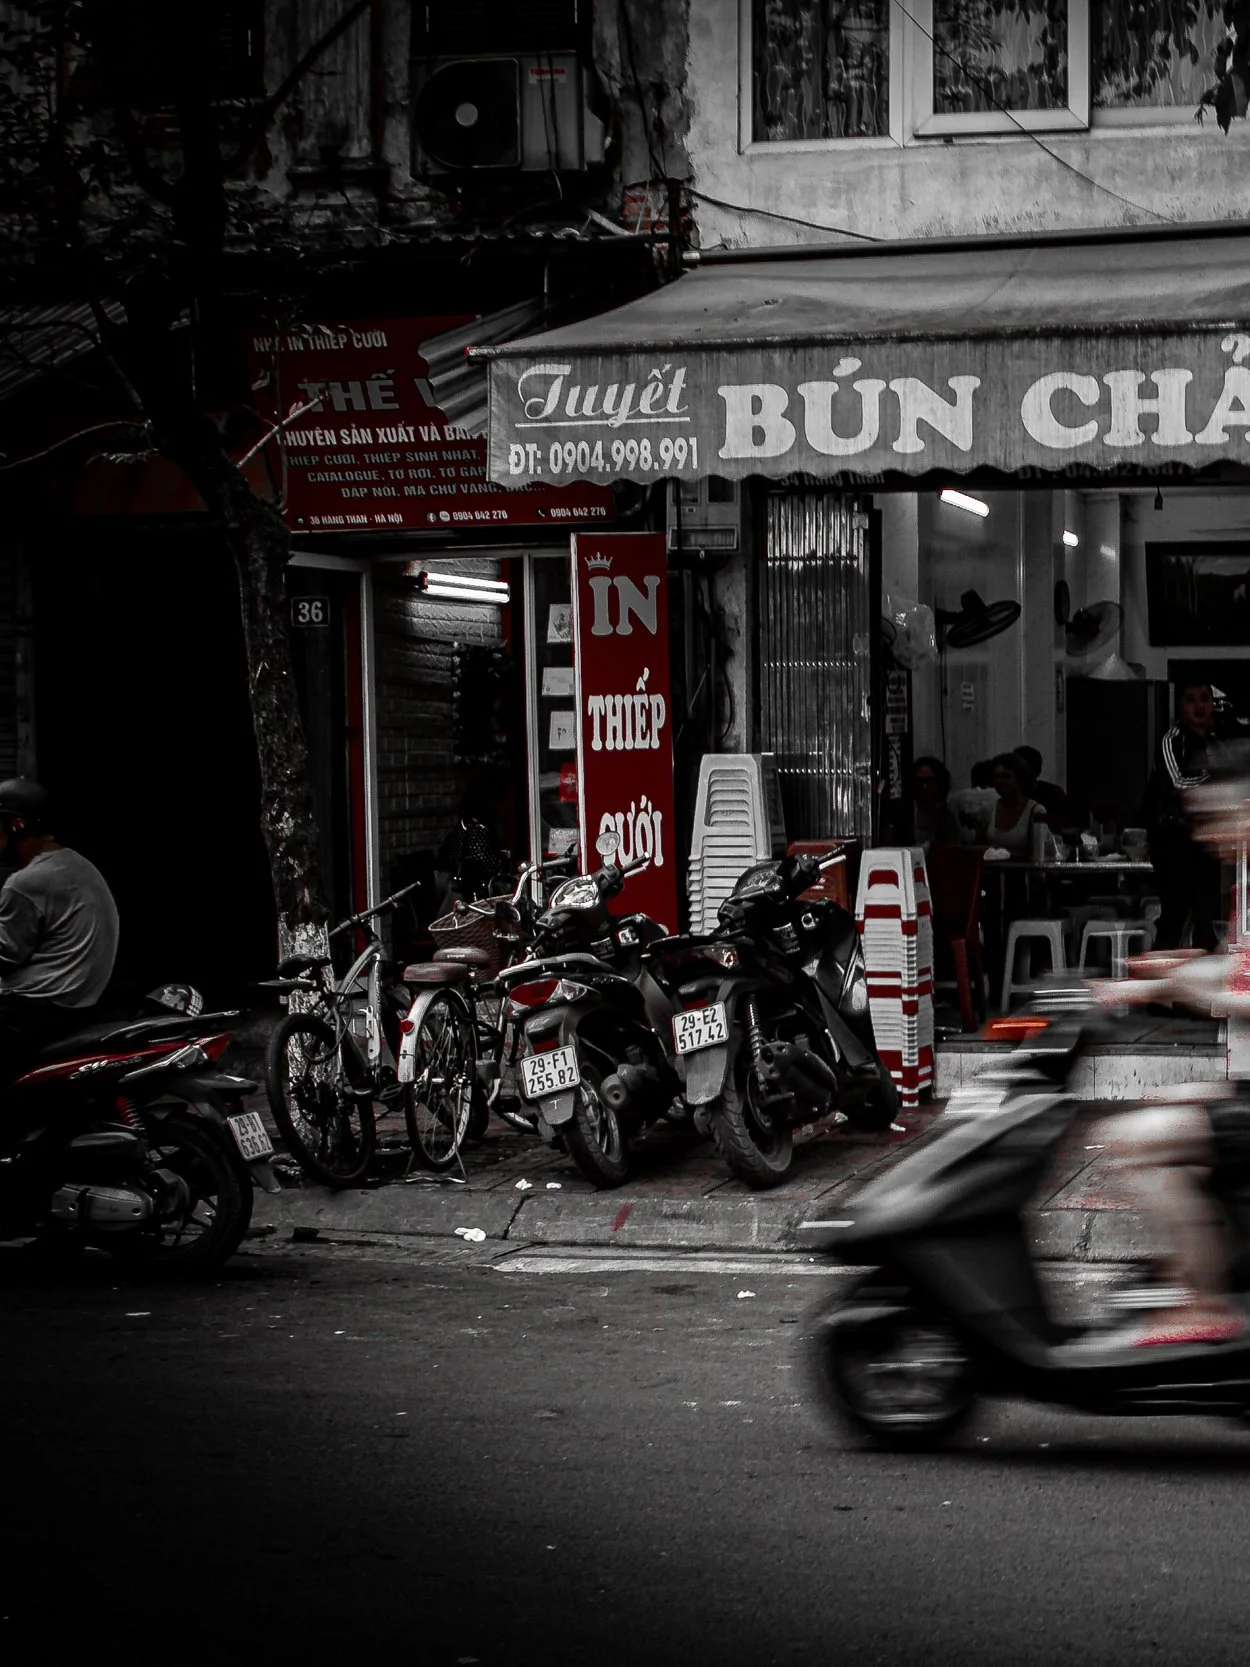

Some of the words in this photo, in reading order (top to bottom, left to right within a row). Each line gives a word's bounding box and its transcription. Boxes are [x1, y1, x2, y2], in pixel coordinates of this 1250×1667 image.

[286, 334, 305, 351] IN
[297, 369, 400, 412] THẾ
[518, 362, 690, 428] Tuyết
[717, 356, 981, 459] BÚN
[340, 422, 374, 446] SẢN
[375, 420, 416, 445] XUẤT
[418, 421, 442, 443] VÀ
[405, 451, 438, 462] SINH
[508, 440, 542, 475] ĐT:
[549, 435, 699, 473] 0904.998.991
[298, 601, 323, 623] 36
[588, 575, 661, 636] IN
[588, 666, 666, 751] THIẾP
[680, 1007, 718, 1033] 29-E2
[678, 1022, 724, 1051] 517.42
[528, 1066, 576, 1095] 255.82
[529, 1056, 568, 1077] 29-F1
[235, 1113, 261, 1137] 29-B1
